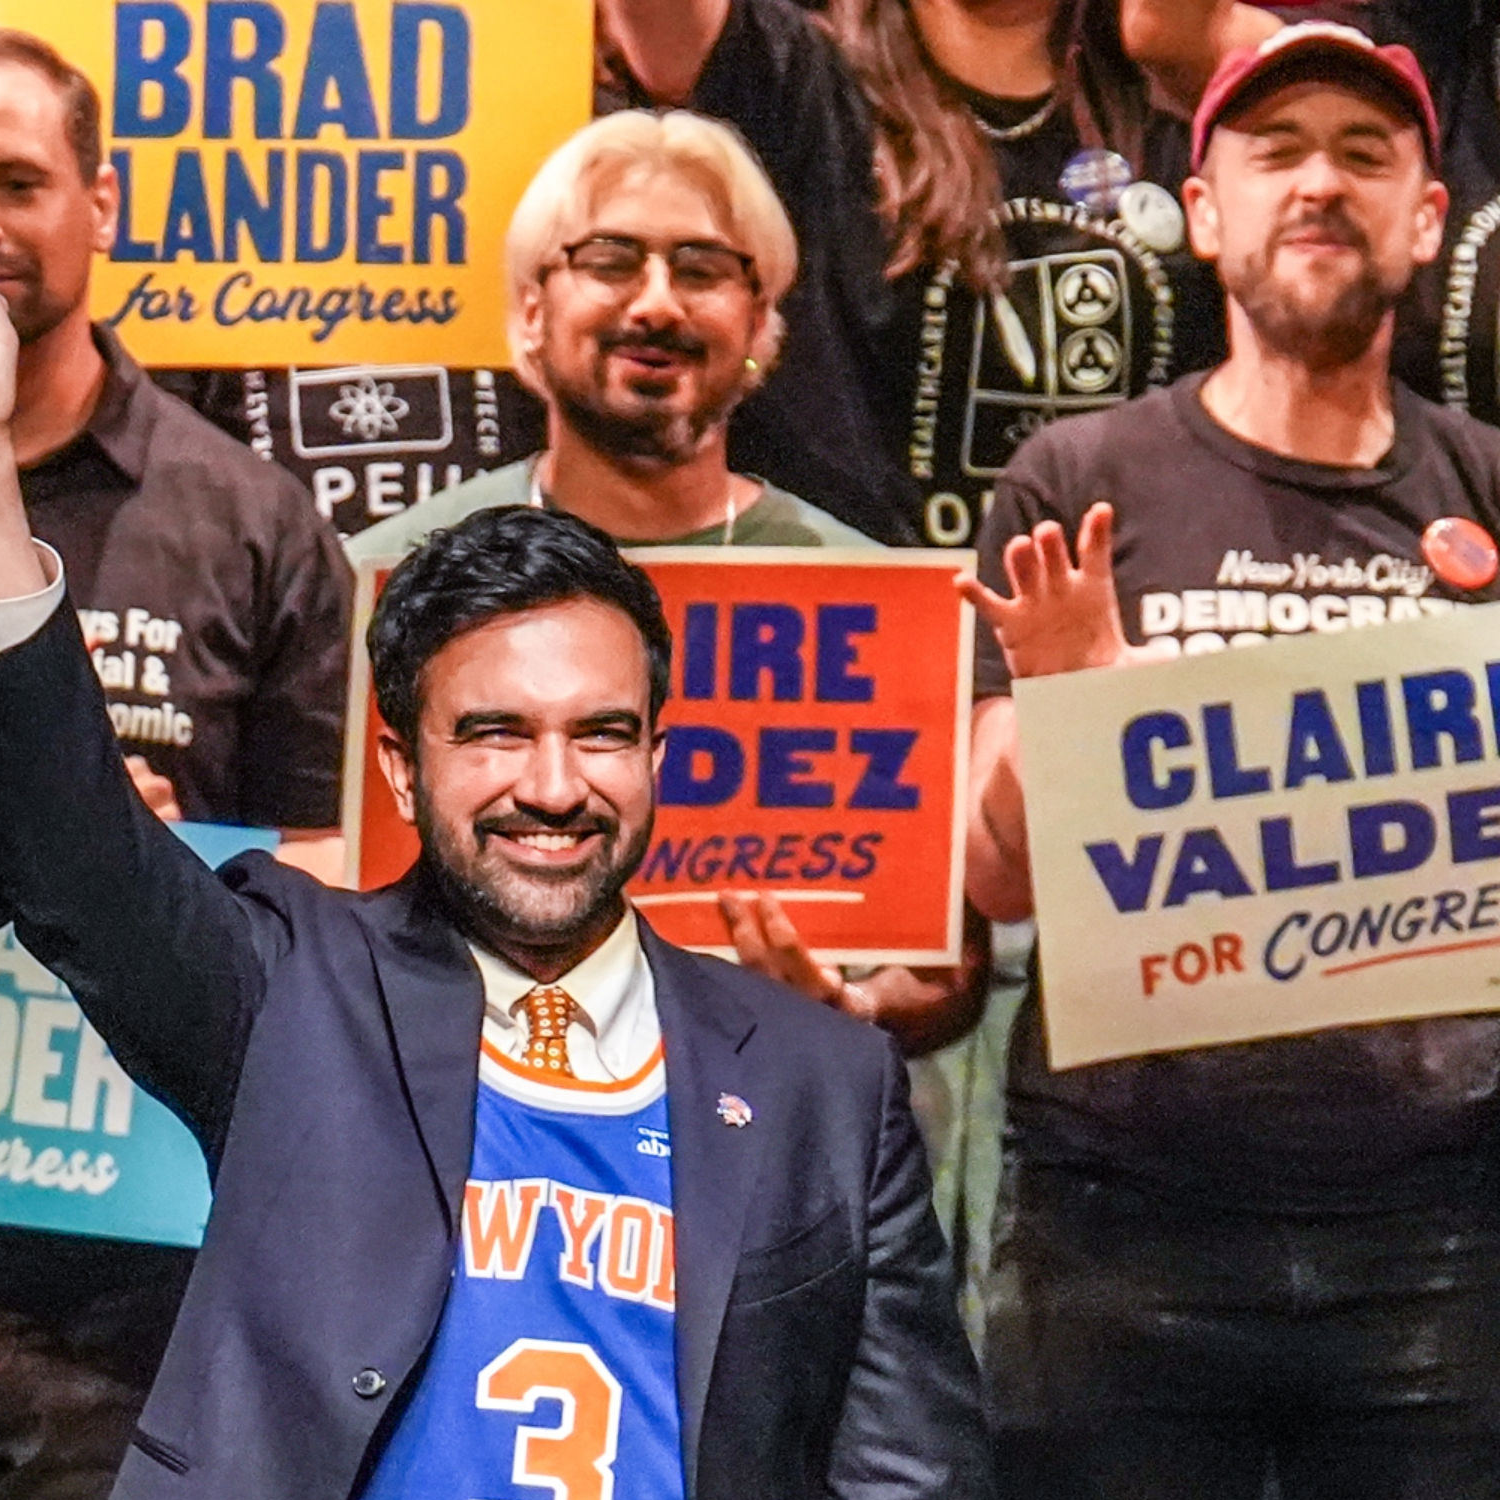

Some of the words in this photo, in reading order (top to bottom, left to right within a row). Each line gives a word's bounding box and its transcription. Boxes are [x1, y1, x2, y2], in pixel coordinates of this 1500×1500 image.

[112, 0, 472, 140] BRAD
[109, 148, 467, 265] LANDER
[108, 272, 196, 328] for
[214, 271, 457, 342] Congress
[312, 461, 490, 522] PEI
[1141, 590, 1455, 634] DEMOCRA
[1216, 549, 1292, 586] New
[1293, 552, 1366, 588] York
[1366, 553, 1434, 596] City
[125, 607, 182, 653] For
[682, 602, 877, 703] IRE
[108, 701, 194, 747] omic
[1121, 662, 1500, 810] CLAIR
[659, 725, 921, 810] DEZ
[640, 832, 885, 884] NGRESS
[1084, 788, 1500, 914] VALDE
[1140, 933, 1244, 996] FOR
[1264, 885, 1500, 981] CONGRE
[549, 1179, 675, 1313] YO
